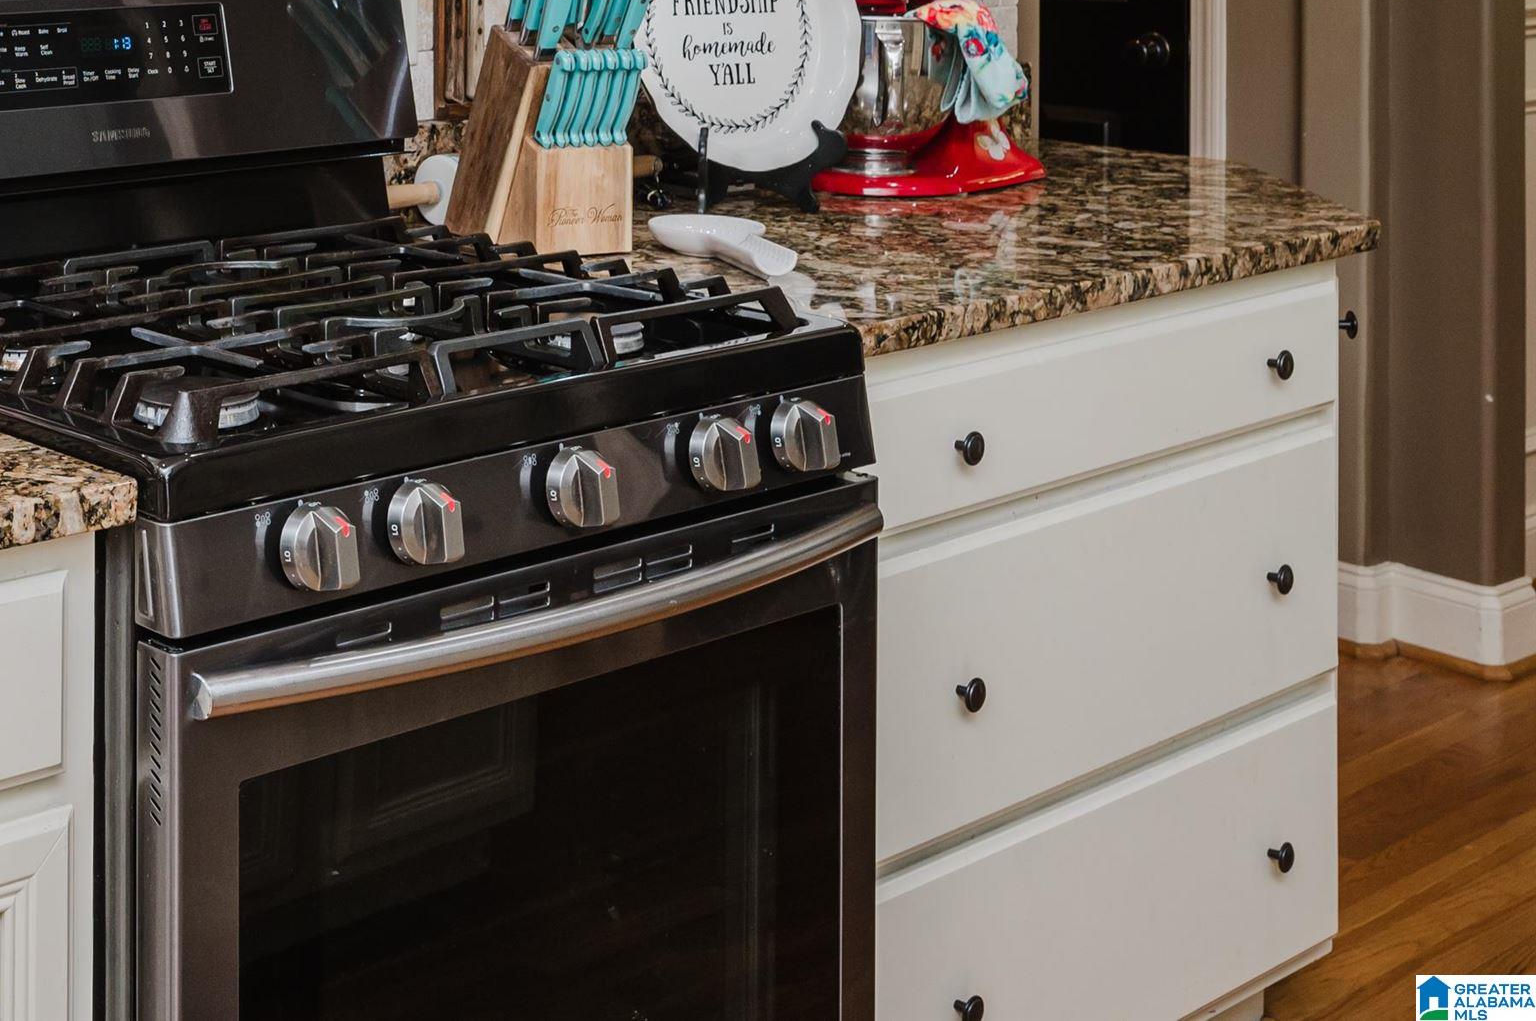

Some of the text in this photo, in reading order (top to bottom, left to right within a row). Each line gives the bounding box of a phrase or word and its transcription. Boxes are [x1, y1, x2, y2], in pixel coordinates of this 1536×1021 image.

[162, 20, 167, 28] 2
[179, 19, 184, 27] 3
[722, 22, 733, 36] IS
[164, 35, 169, 43] 5
[181, 34, 186, 42] 6
[682, 31, 776, 62] homemade
[148, 52, 153, 60] 7
[166, 51, 171, 59] 8
[709, 62, 756, 87] Y'ALL
[91, 127, 151, 143] SAMSUNG
[587, 202, 623, 224] Woman
[774, 437, 782, 448] LO
[693, 456, 701, 468] LO
[550, 489, 558, 502] LO
[391, 524, 399, 536] LO
[284, 550, 292, 562] LO
